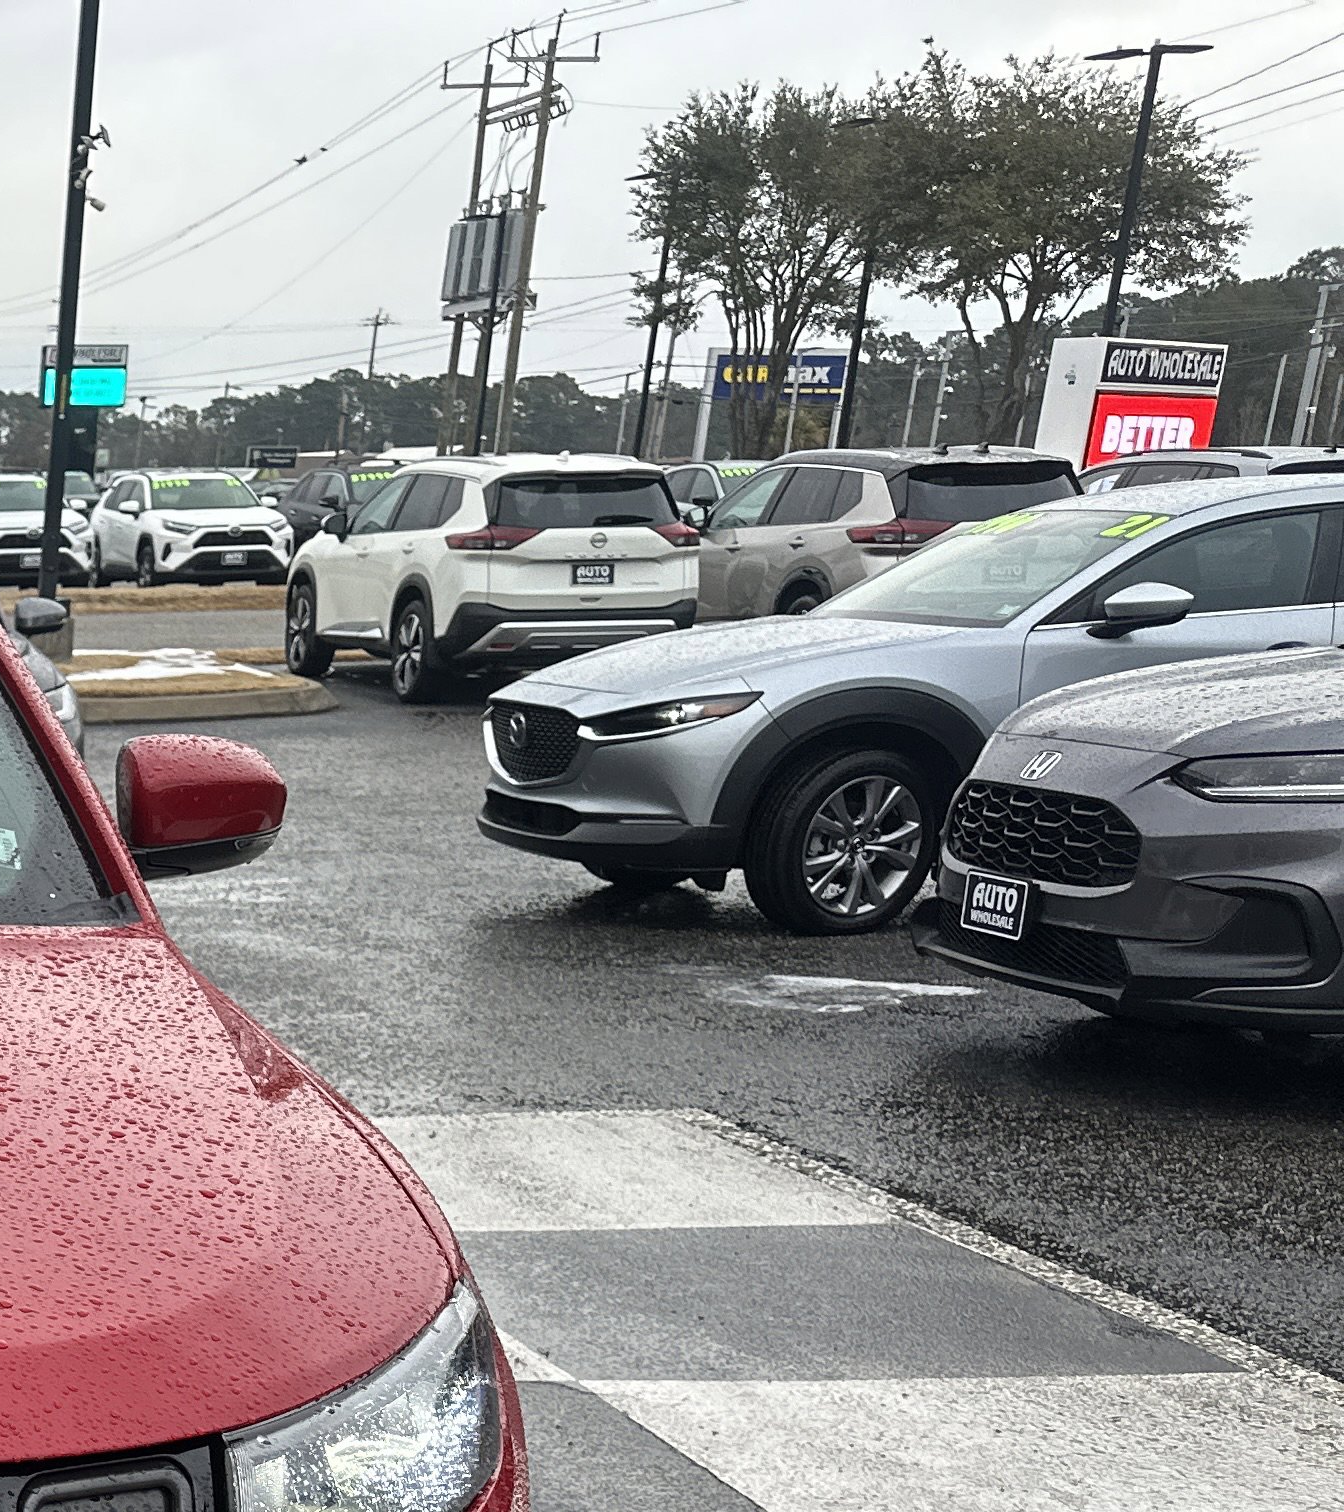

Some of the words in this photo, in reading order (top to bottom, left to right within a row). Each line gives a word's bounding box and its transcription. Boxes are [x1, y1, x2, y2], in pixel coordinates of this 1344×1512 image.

[1108, 349, 1147, 378] AUTO
[1147, 349, 1222, 382] WHOLESALE
[1100, 415, 1195, 454] BETTER
[1099, 514, 1170, 540] 21
[576, 565, 610, 577] AUTO
[972, 882, 1018, 914] AUTO
[970, 908, 1015, 930] WHOLESALE
